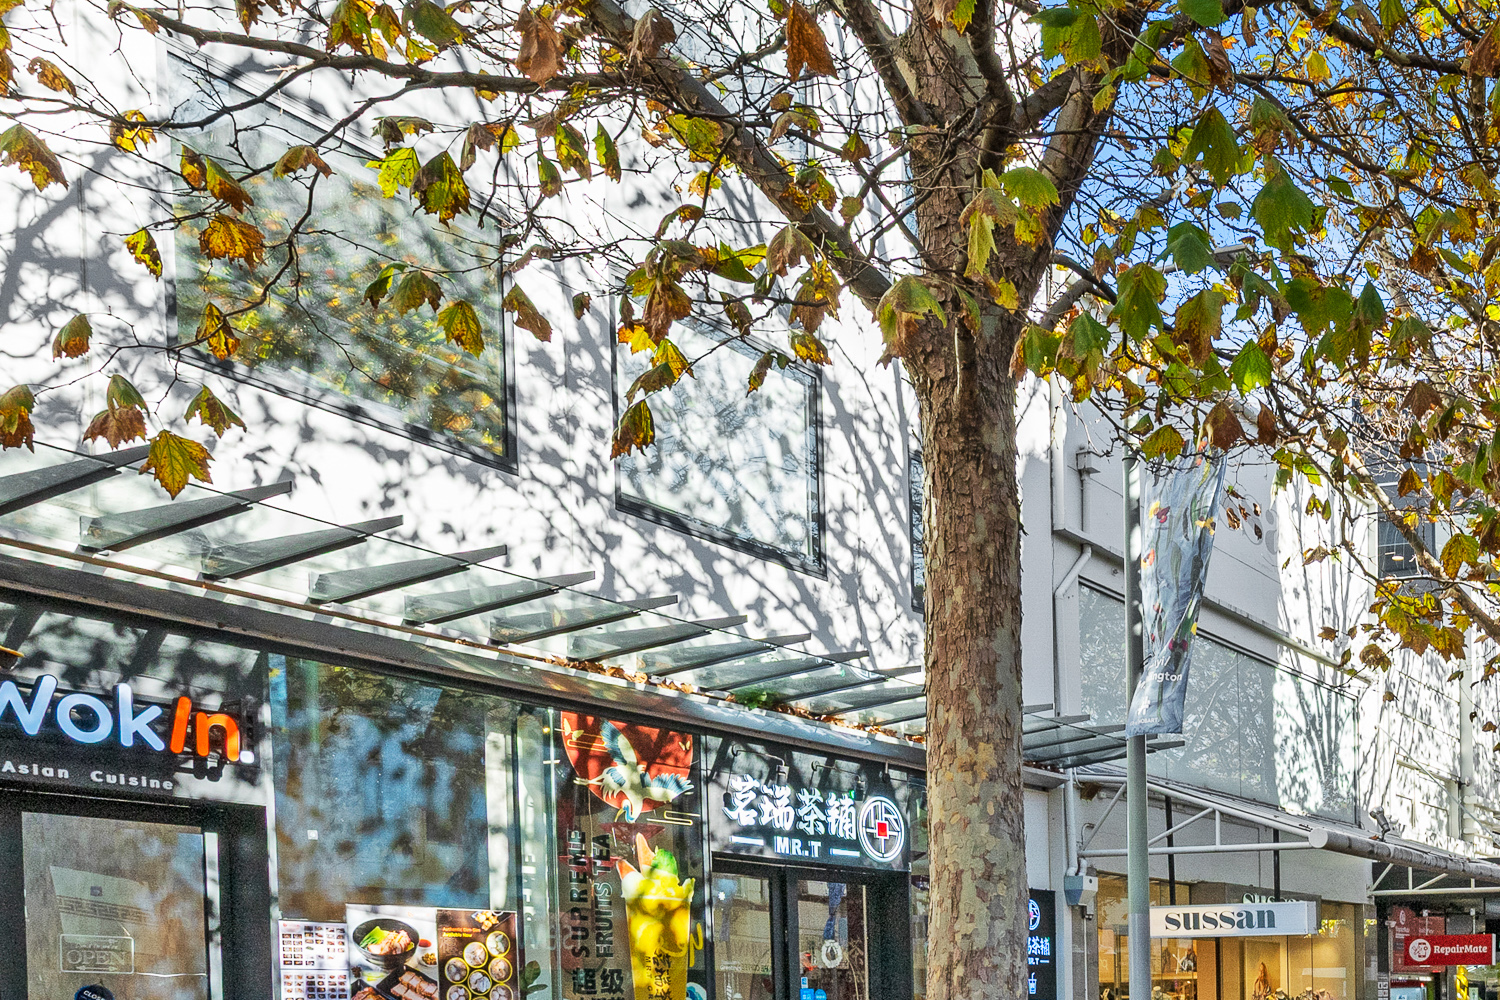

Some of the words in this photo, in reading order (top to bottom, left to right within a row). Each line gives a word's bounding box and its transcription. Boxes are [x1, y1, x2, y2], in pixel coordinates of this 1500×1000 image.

[2, 760, 69, 779] Asian
[90, 770, 173, 790] Cuisine
[592, 833, 612, 873] TEA
[773, 836, 822, 858] MR.T
[567, 830, 590, 958] SUPREME
[594, 882, 614, 958] FRUITS
[1165, 909, 1276, 931] sussan
[67, 949, 127, 965] OPEN
[1433, 944, 1488, 955] RepairMate
